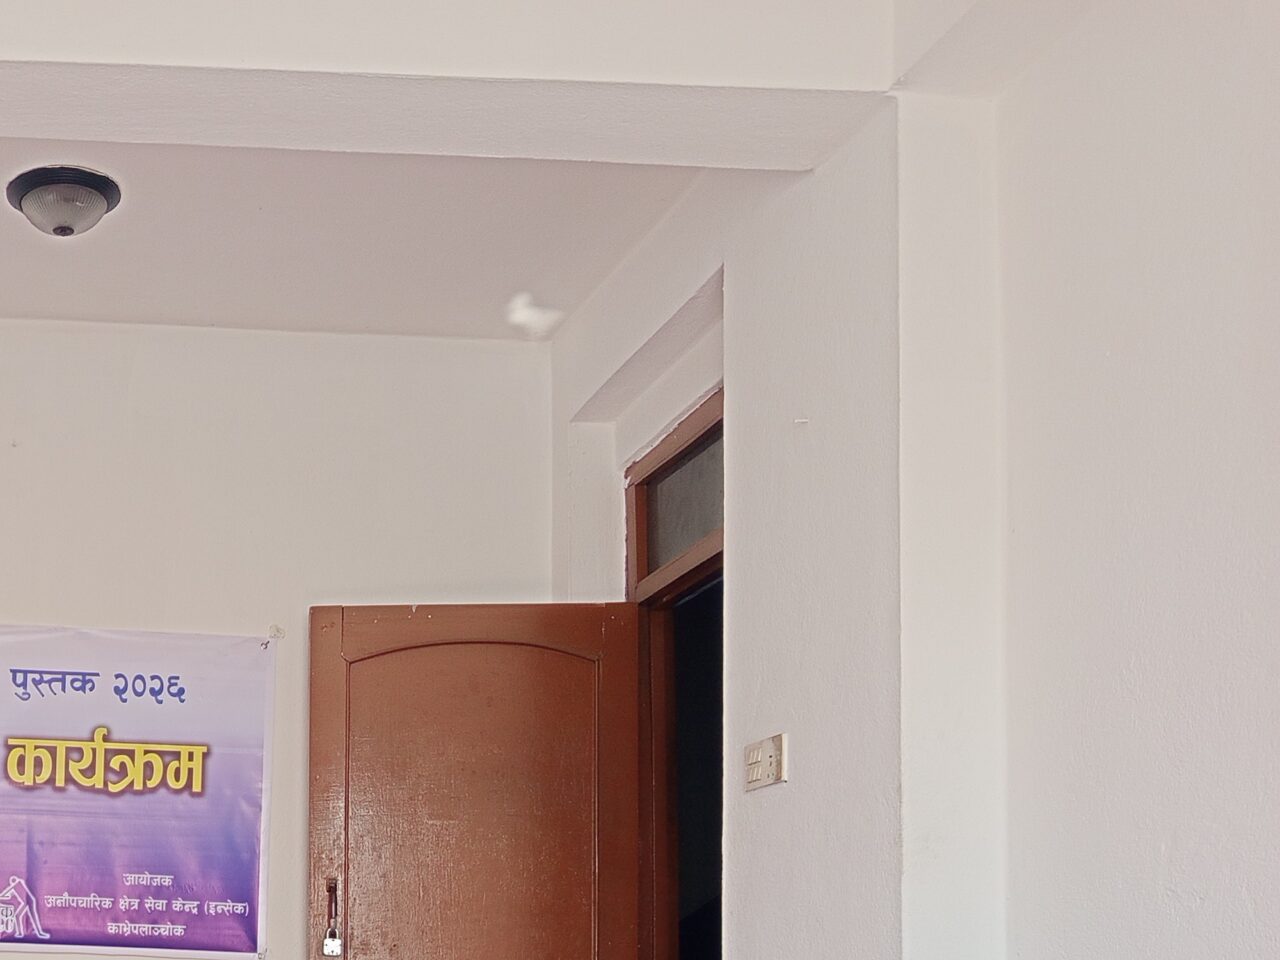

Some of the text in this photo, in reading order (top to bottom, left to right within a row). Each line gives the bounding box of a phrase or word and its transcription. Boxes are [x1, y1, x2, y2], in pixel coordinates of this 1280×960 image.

[10, 668, 100, 701] पुस्तक
[113, 672, 186, 704] २०२६
[6, 727, 208, 793] कार्यक्रम
[122, 871, 174, 887] आयोजक
[44, 892, 250, 917] अनौपचारिक क्षेत्र सेवा केन्द्र (इन्सेक)
